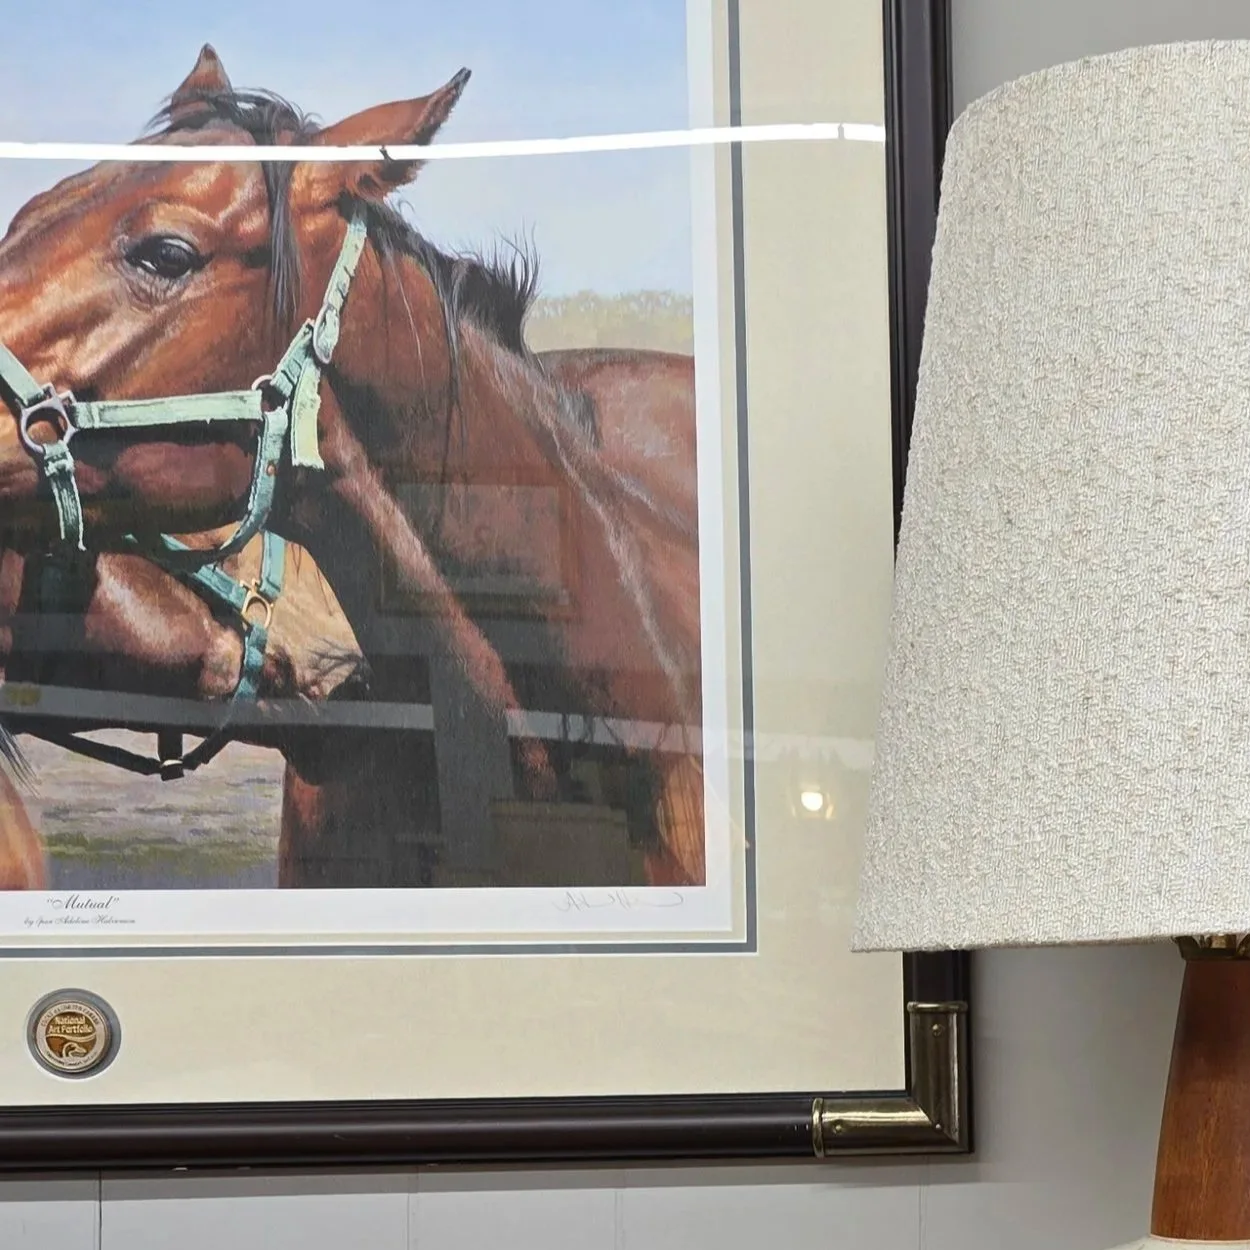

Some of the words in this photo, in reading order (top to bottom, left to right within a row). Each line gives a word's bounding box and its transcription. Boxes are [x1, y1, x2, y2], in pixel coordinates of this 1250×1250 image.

[54, 1015, 86, 1025] National
[48, 1024, 60, 1034] Art
[61, 1024, 93, 1034] Portfolio
